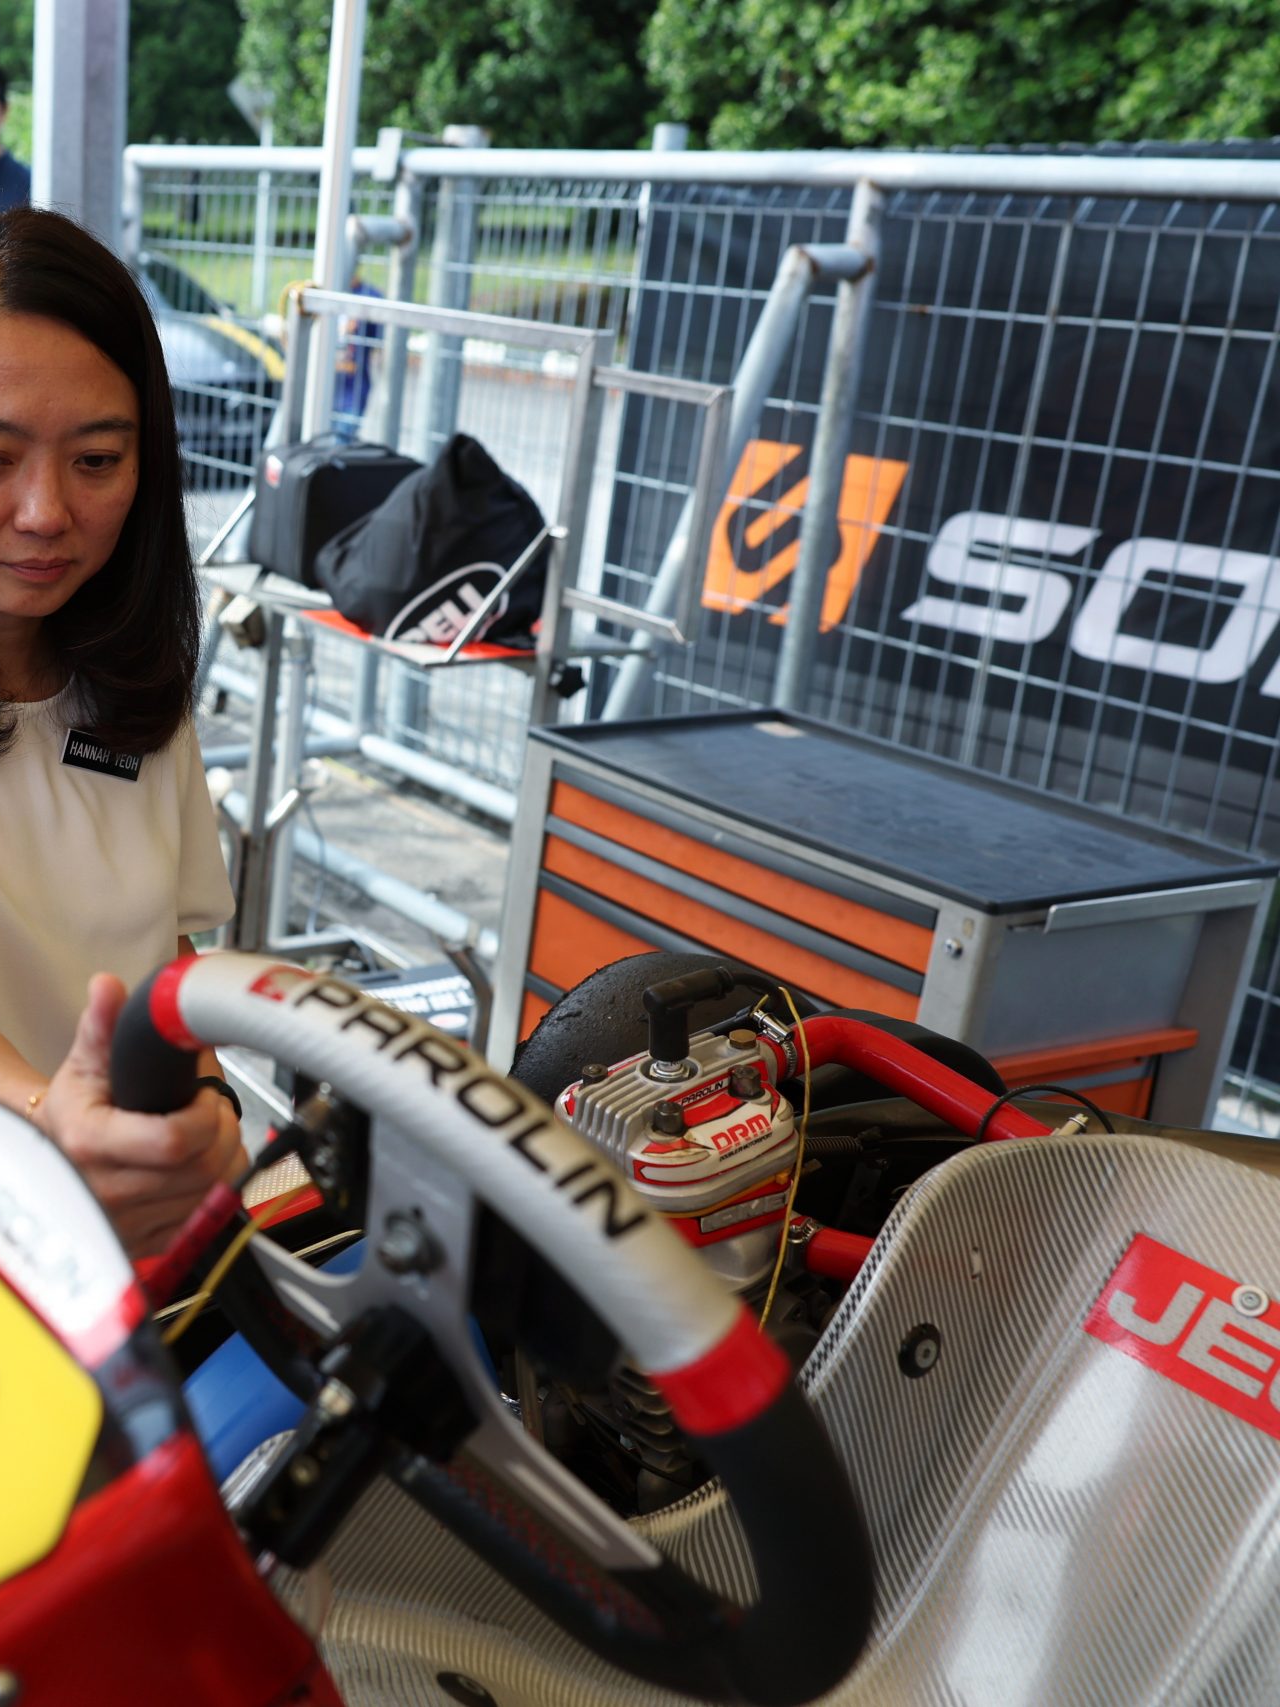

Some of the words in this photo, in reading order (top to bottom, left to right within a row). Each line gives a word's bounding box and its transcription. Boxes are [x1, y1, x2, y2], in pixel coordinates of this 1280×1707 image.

[900, 511, 1280, 698] SO
[69, 740, 111, 764] HANNAH
[115, 752, 140, 771] YEOH
[295, 977, 650, 1239] PAROLIN
[681, 1080, 725, 1107] PAROLIN
[710, 1113, 772, 1156] DRM
[1107, 1281, 1280, 1413] JE
